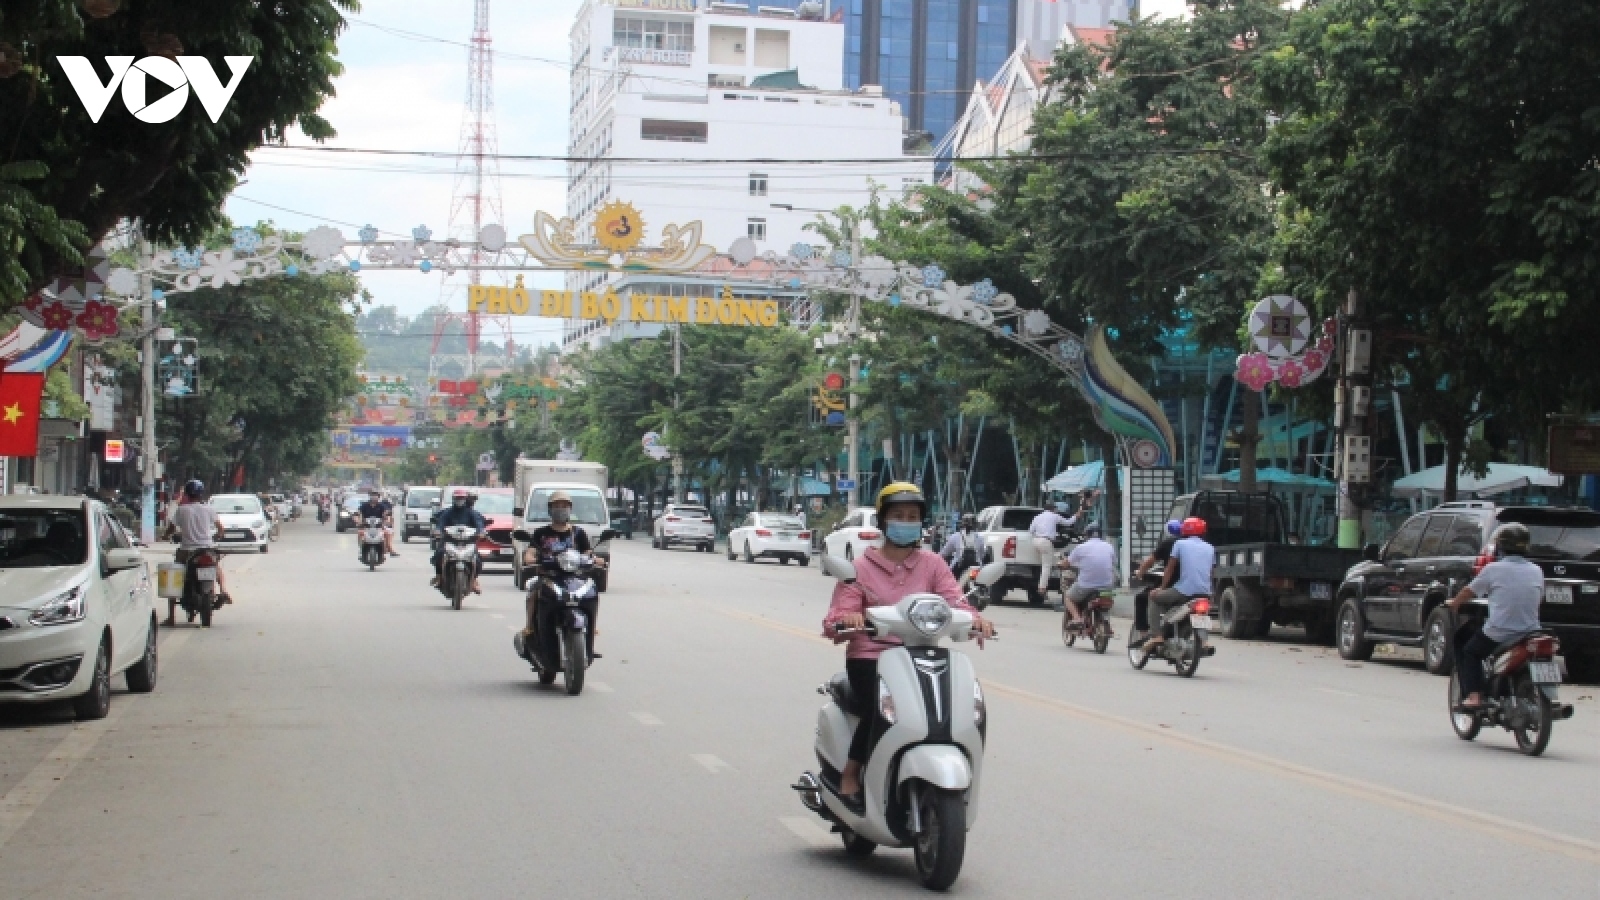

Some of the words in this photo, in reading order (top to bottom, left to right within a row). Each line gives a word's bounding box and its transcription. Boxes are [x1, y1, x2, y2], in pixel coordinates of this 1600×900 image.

[540, 289, 573, 318] ĐI
[580, 285, 622, 327] BỘ
[630, 293, 688, 322] KIM
[694, 284, 778, 327] ĐỒNG
